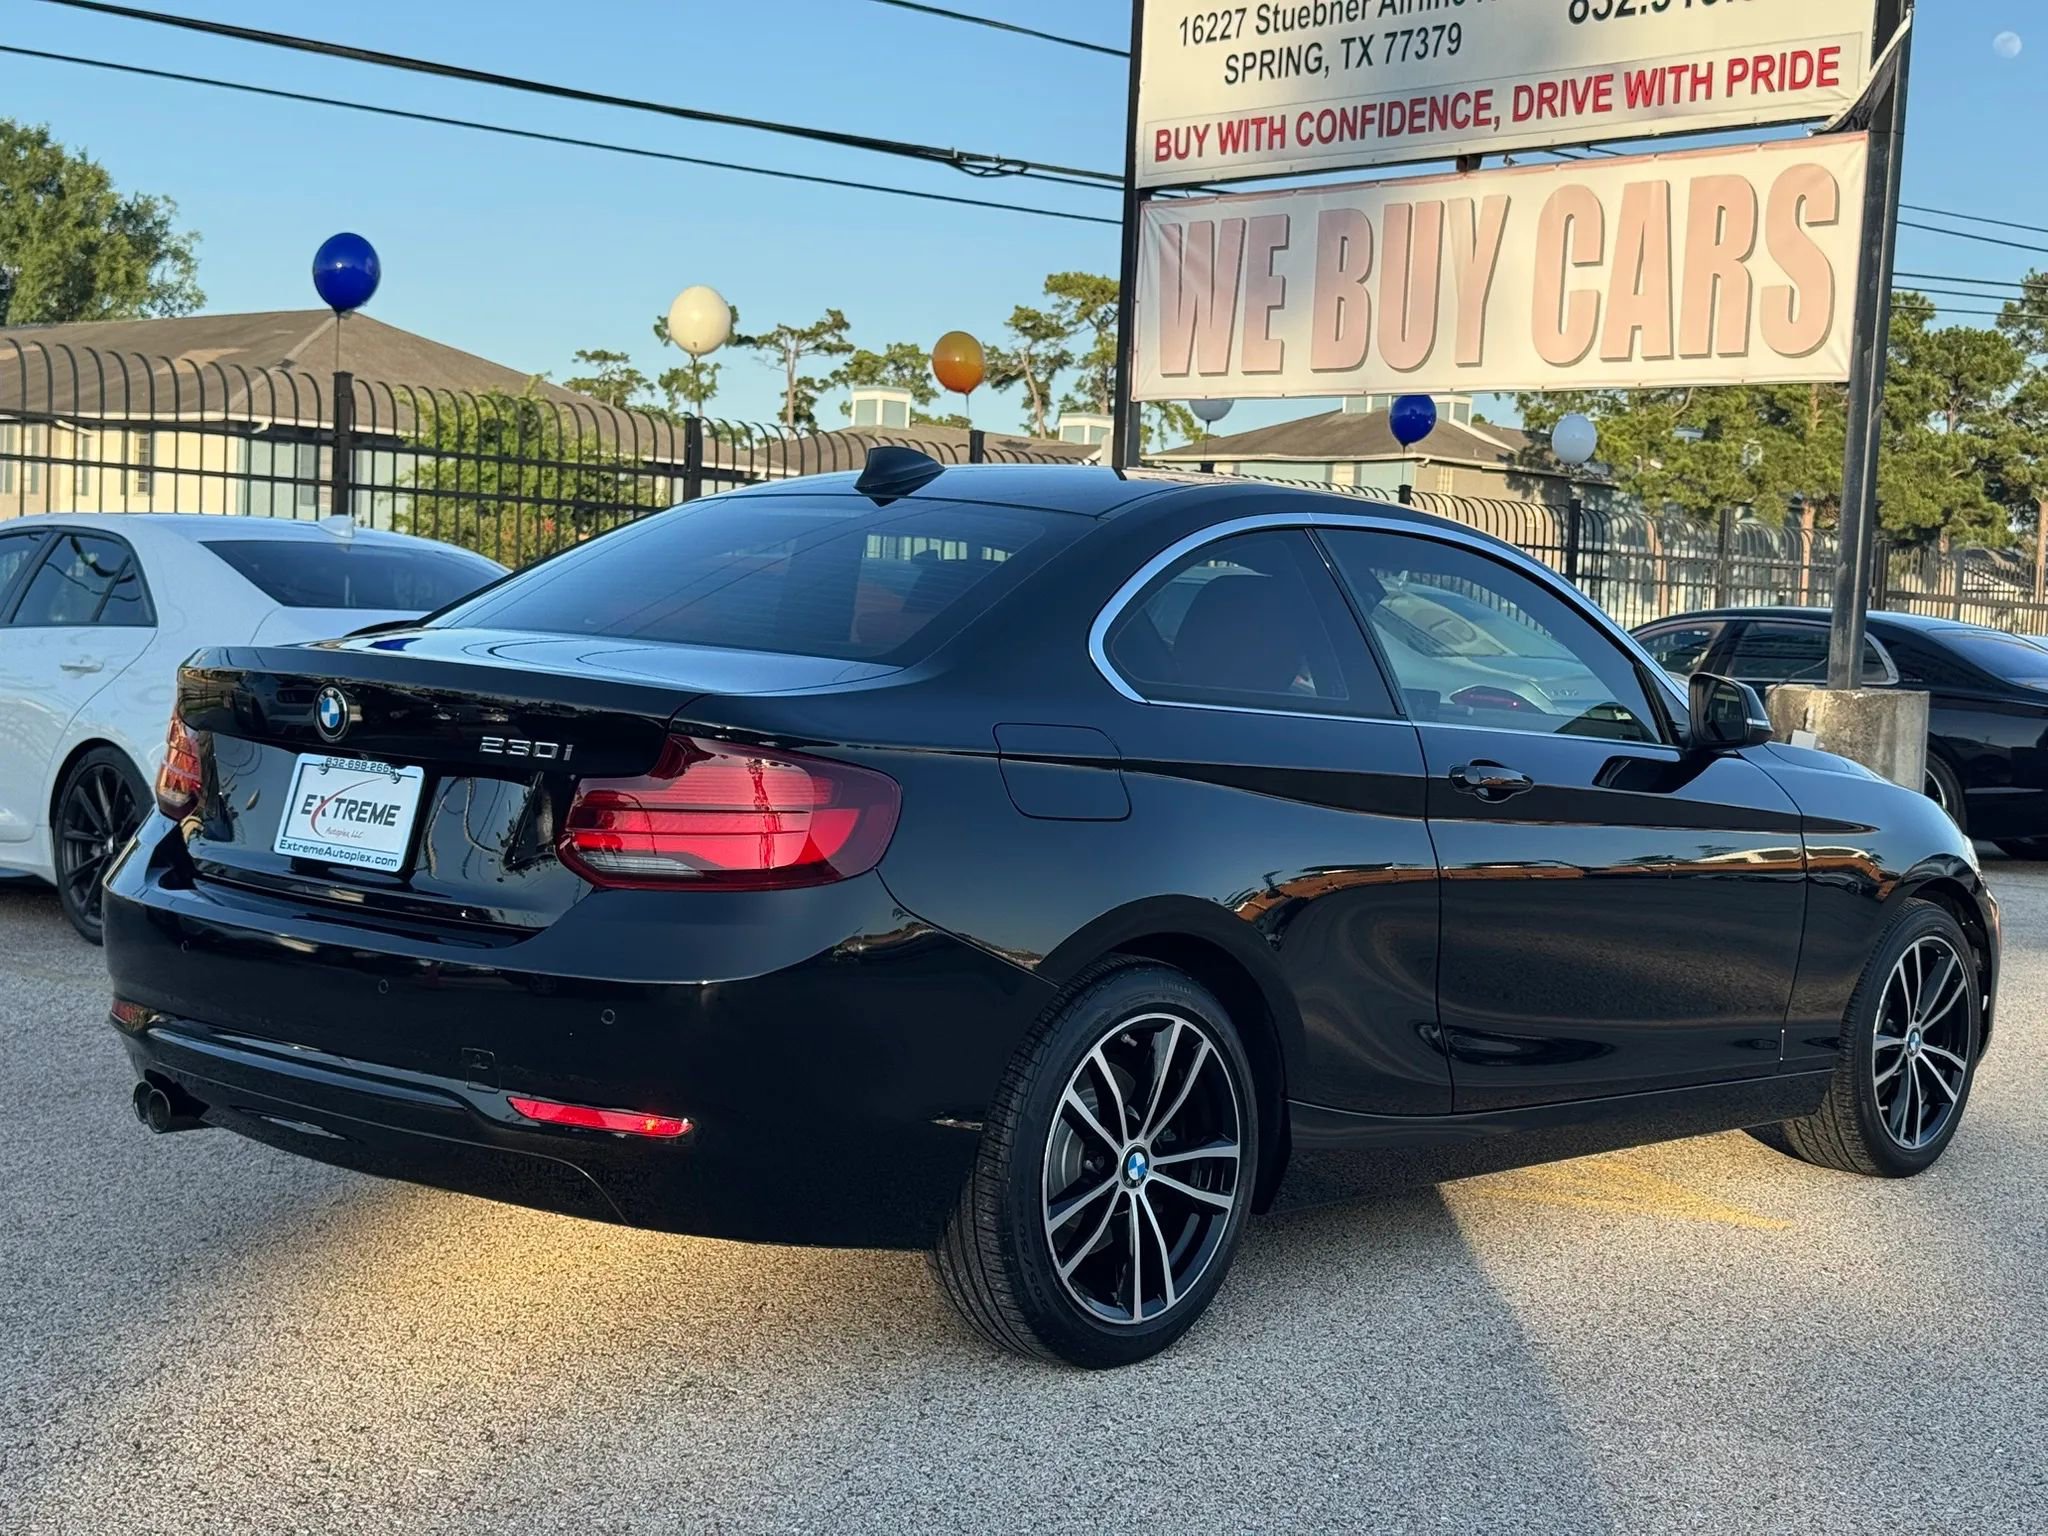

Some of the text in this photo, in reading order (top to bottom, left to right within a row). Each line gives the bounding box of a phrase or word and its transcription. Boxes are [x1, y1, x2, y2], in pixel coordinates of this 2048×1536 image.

[1179, 7, 1247, 47] 16227
[1255, 0, 1367, 36] Stuebner
[1224, 22, 1462, 85] SPRING, TX 77379
[1155, 45, 1841, 163] BUY WITH CONFIDENCE, DRIVE WITH PRIDE
[1159, 163, 1840, 377] WE BUY CARS
[479, 736, 574, 761] 230i
[300, 794, 401, 827] EXTREME
[279, 839, 398, 867] ExtremeAutoplex.com
